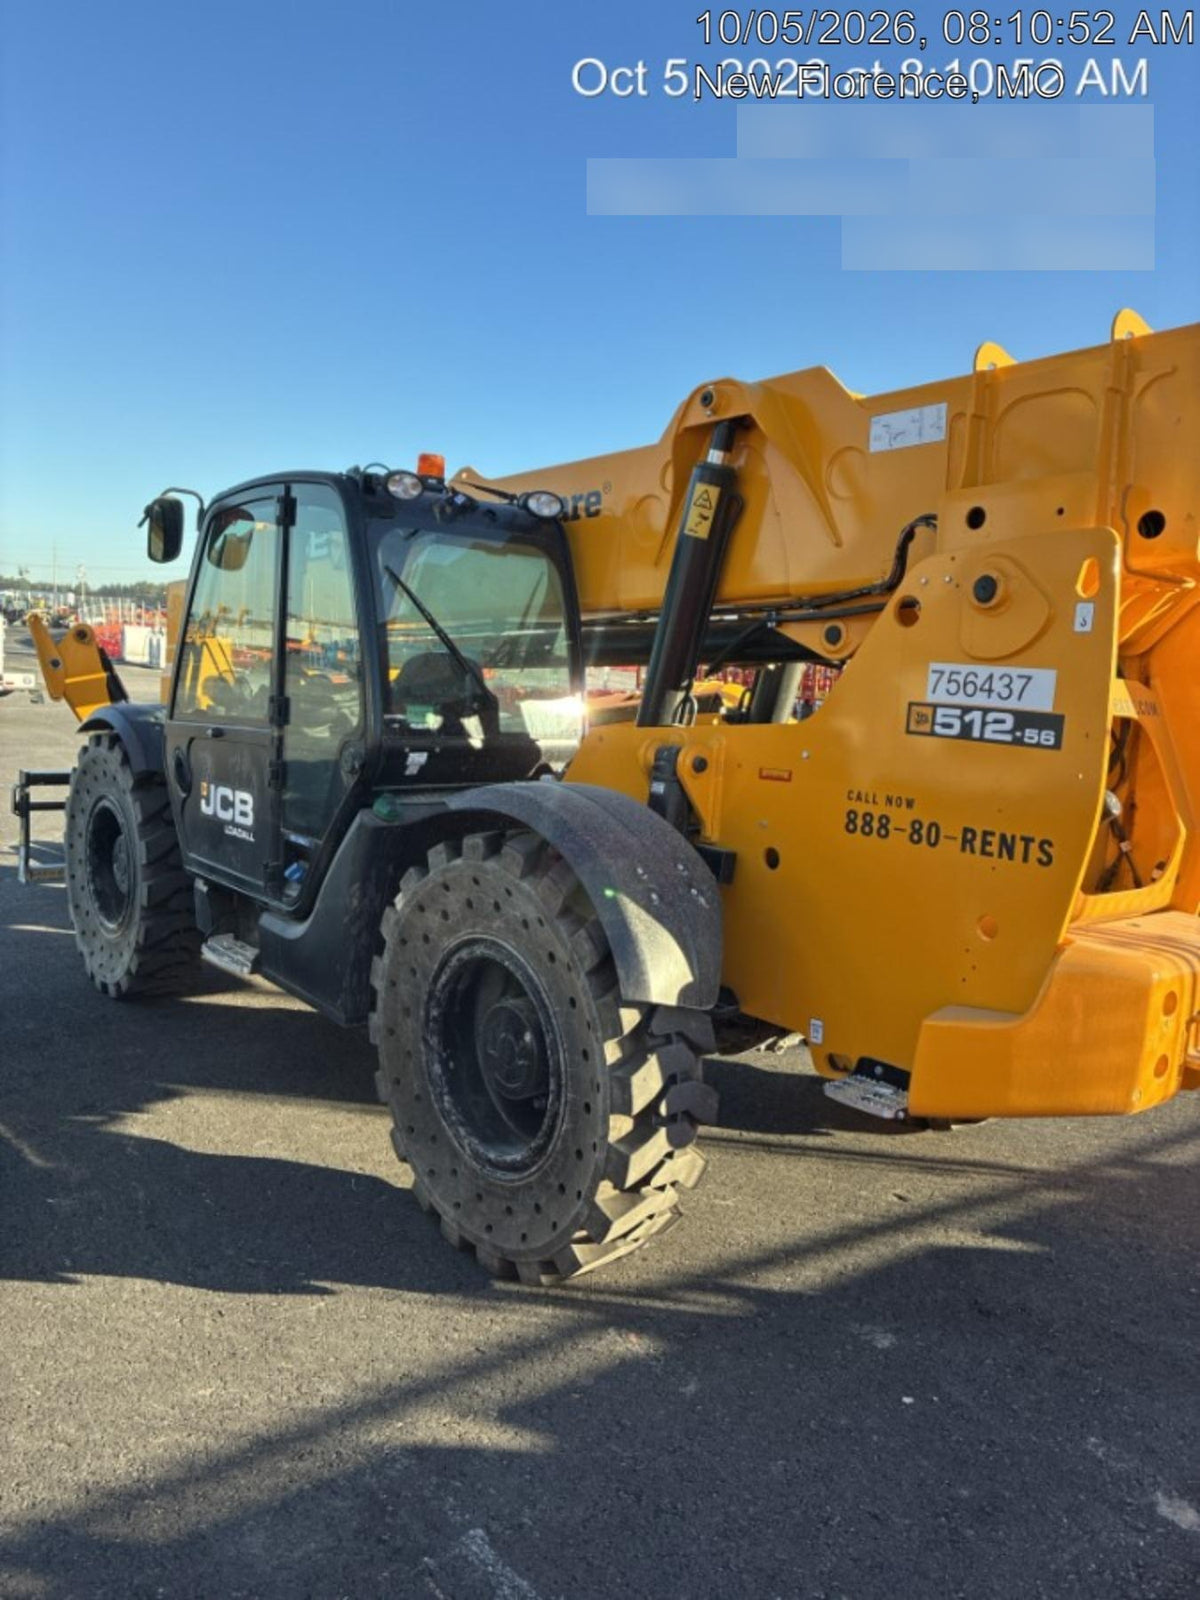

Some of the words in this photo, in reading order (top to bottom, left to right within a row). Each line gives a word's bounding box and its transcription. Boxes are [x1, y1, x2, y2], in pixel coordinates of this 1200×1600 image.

[931, 669, 1033, 702] 756437
[933, 706, 1056, 747] 512-56
[200, 782, 254, 825] JCB
[846, 789, 879, 805] CALL
[885, 794, 915, 810] NOW
[844, 809, 1055, 867] 888-80-RENTS
